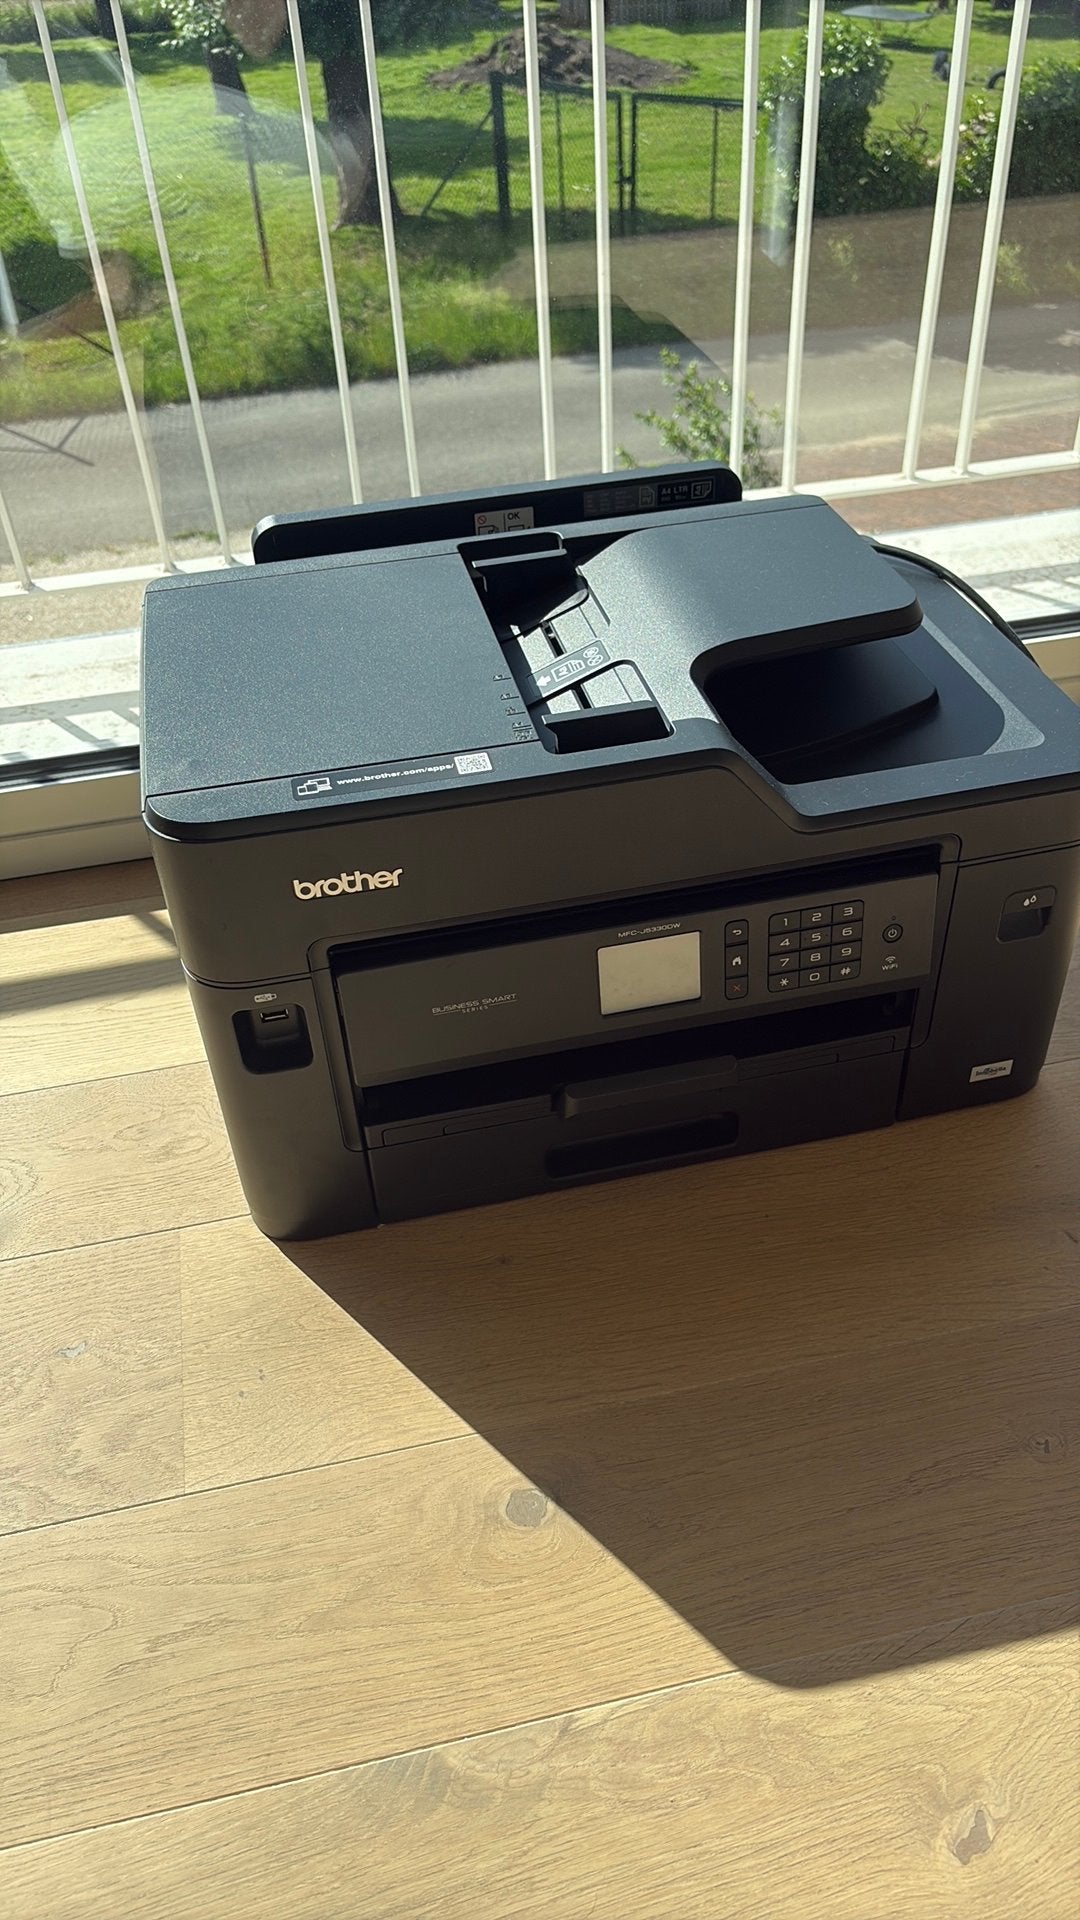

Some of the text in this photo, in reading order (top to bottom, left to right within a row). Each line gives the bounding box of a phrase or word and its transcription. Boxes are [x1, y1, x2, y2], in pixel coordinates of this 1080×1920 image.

[660, 484, 689, 495] A4 LTR
[507, 511, 521, 520] OK
[336, 763, 455, 785] www.brother.com/apps/
[293, 868, 403, 900] brother
[782, 906, 853, 926] 1 2 3
[617, 922, 681, 938] MFC-J5330DW
[779, 927, 852, 946] 4 5 6
[779, 947, 852, 967] 7 8 9
[840, 966, 851, 976] #
[431, 993, 518, 1014] BUSINESS SMART
[461, 1005, 489, 1014] SERIES
